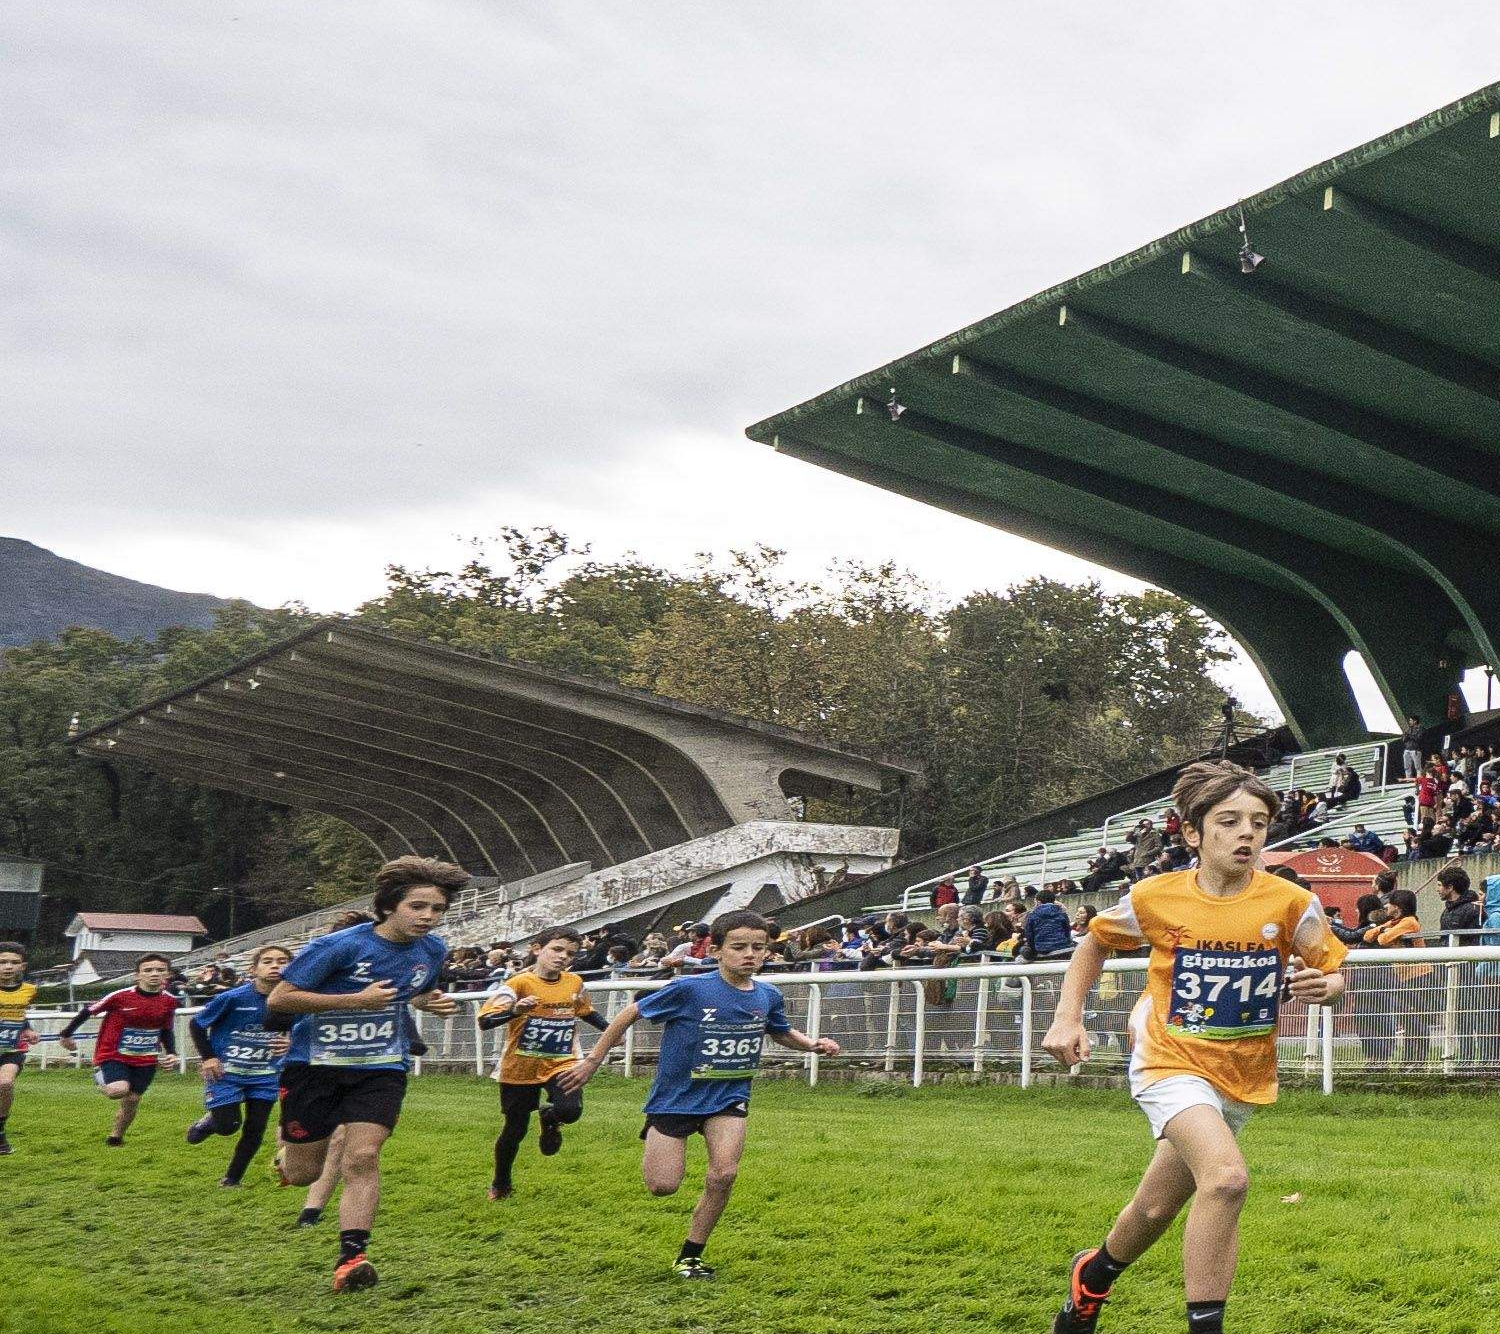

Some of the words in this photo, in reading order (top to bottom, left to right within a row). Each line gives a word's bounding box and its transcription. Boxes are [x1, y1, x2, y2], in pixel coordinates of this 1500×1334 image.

[1182, 953, 1277, 969] gipuzkoa
[1176, 972, 1278, 1002] 3714
[319, 1020, 394, 1042] 3504
[524, 1027, 573, 1043] 3716
[701, 1037, 760, 1056] 3363
